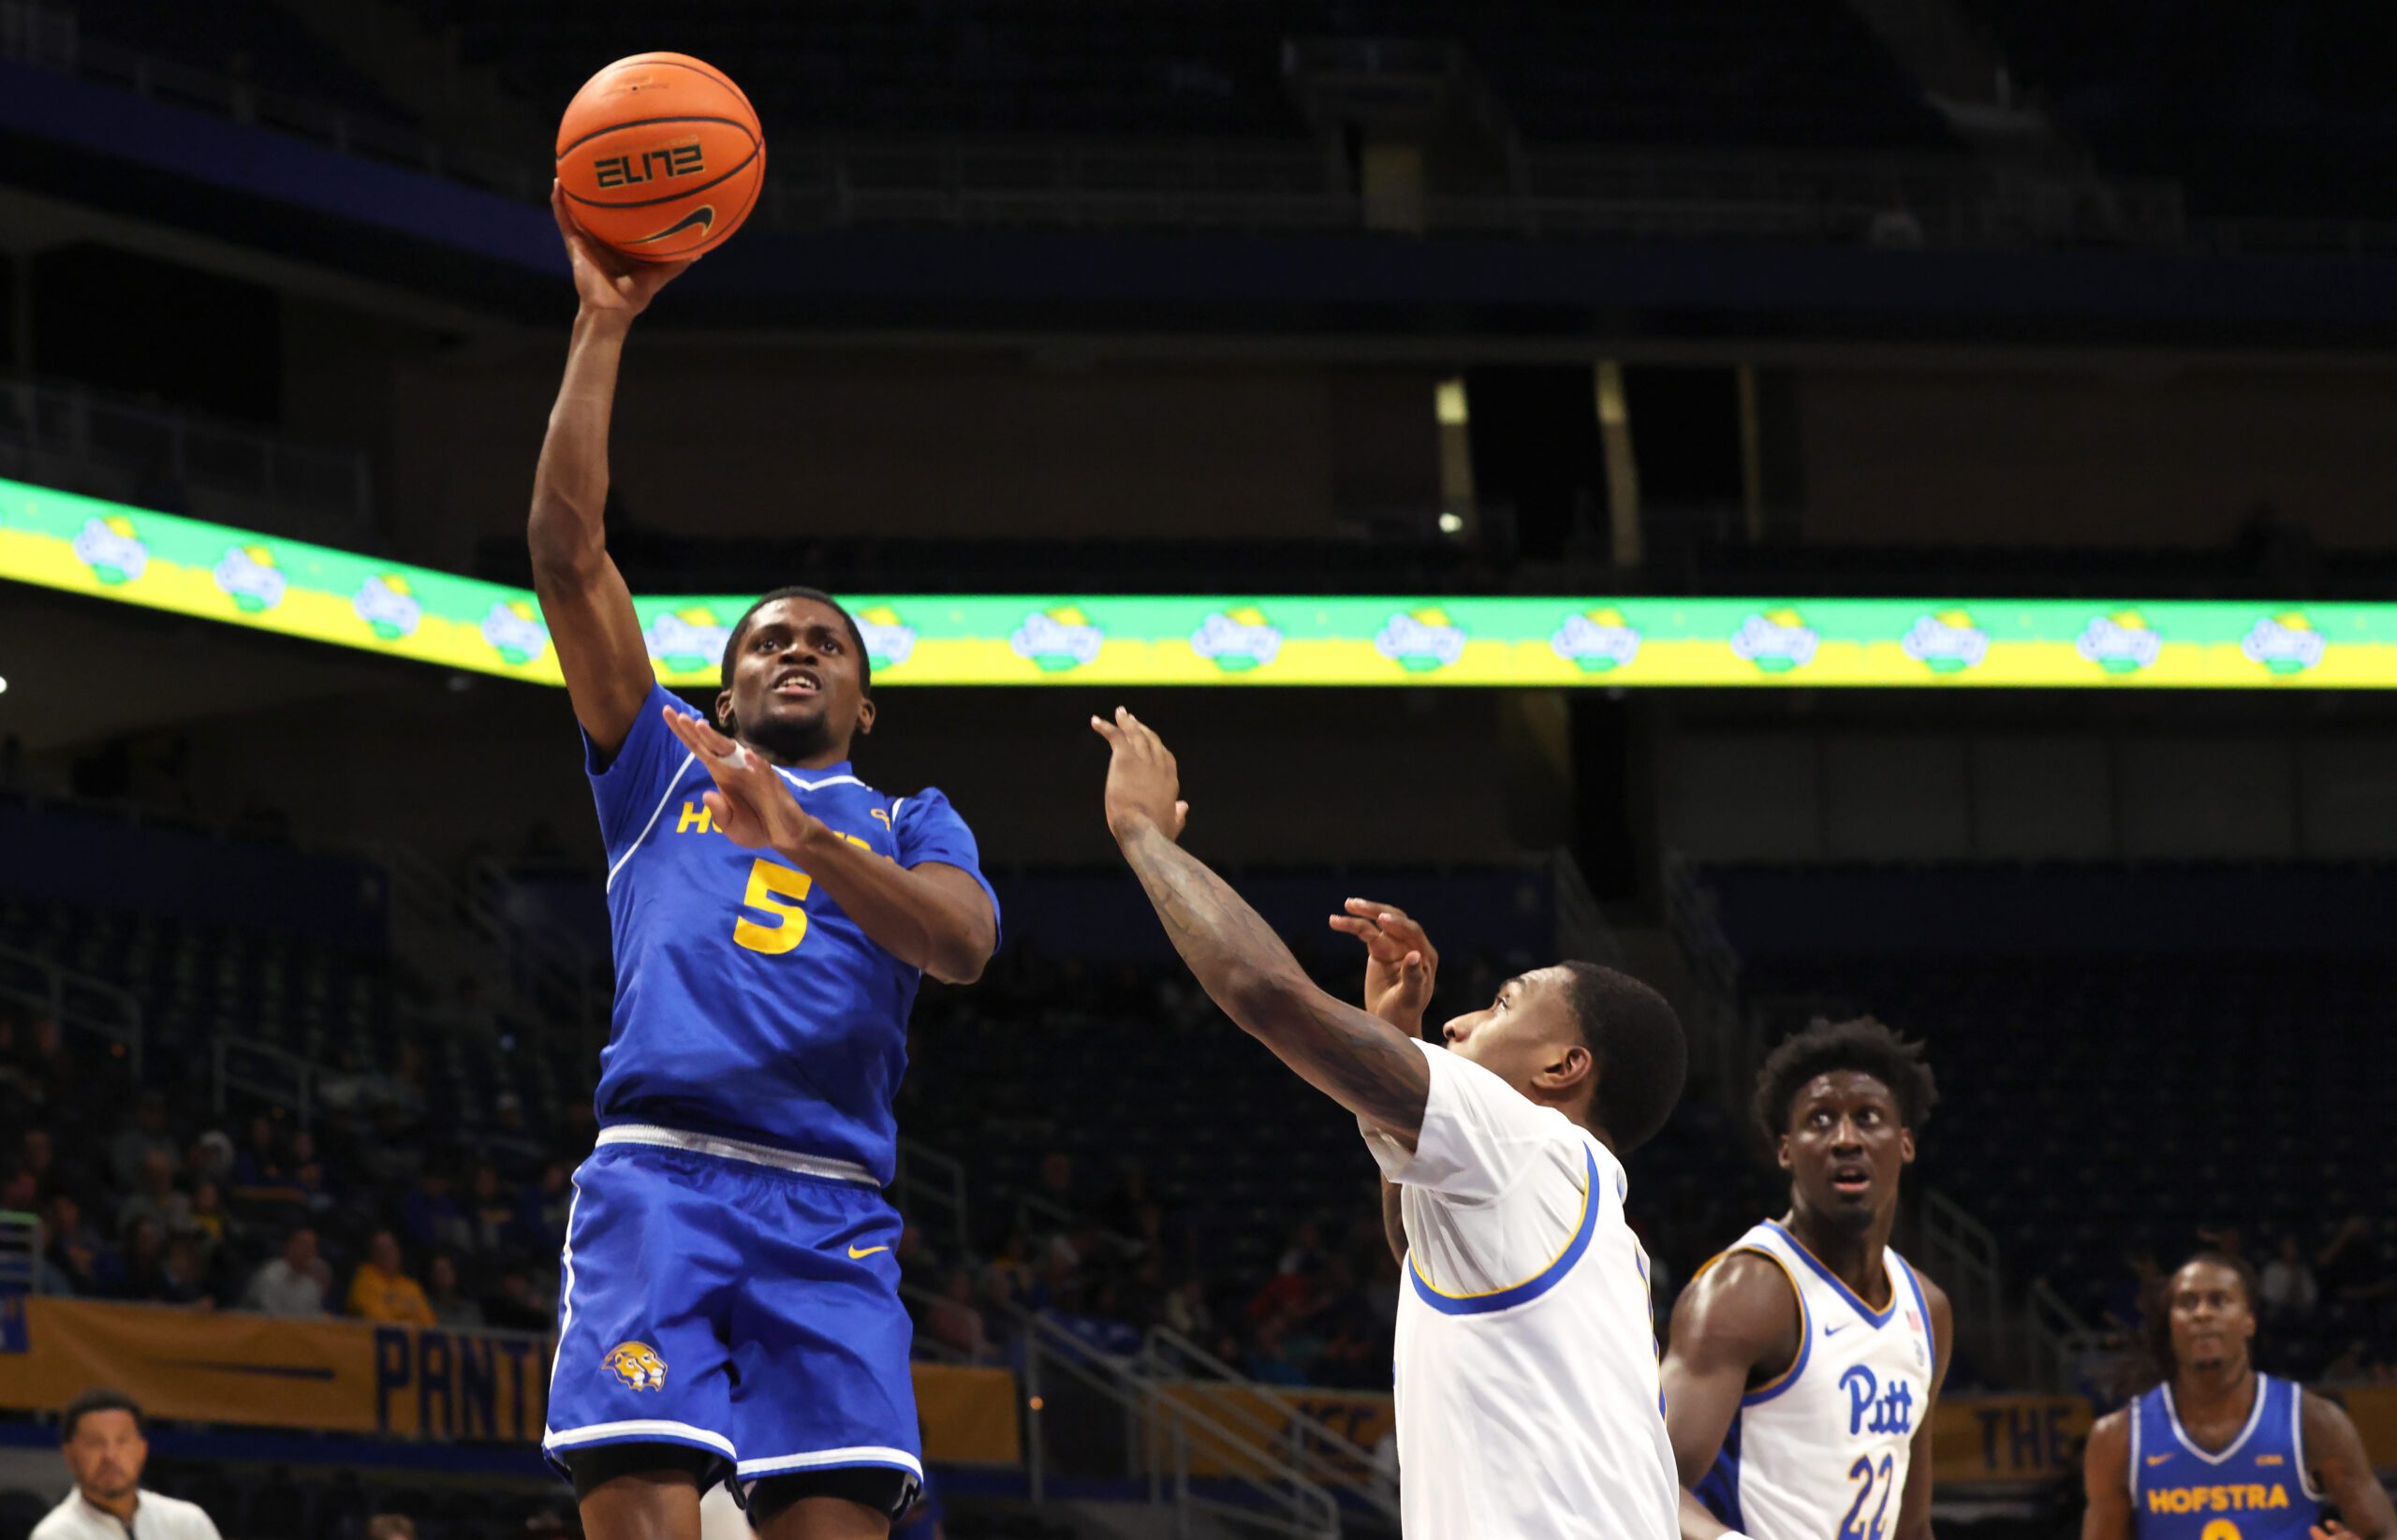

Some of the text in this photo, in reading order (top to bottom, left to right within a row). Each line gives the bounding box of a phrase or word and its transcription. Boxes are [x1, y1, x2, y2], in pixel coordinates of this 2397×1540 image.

[594, 143, 705, 189] ELITE
[732, 857, 813, 955] 5
[1838, 1363, 1913, 1436] Pitt
[1976, 1407, 2072, 1470] THE
[1836, 1451, 1894, 1540] 22
[2146, 1483, 2290, 1515] HOFSTRA
